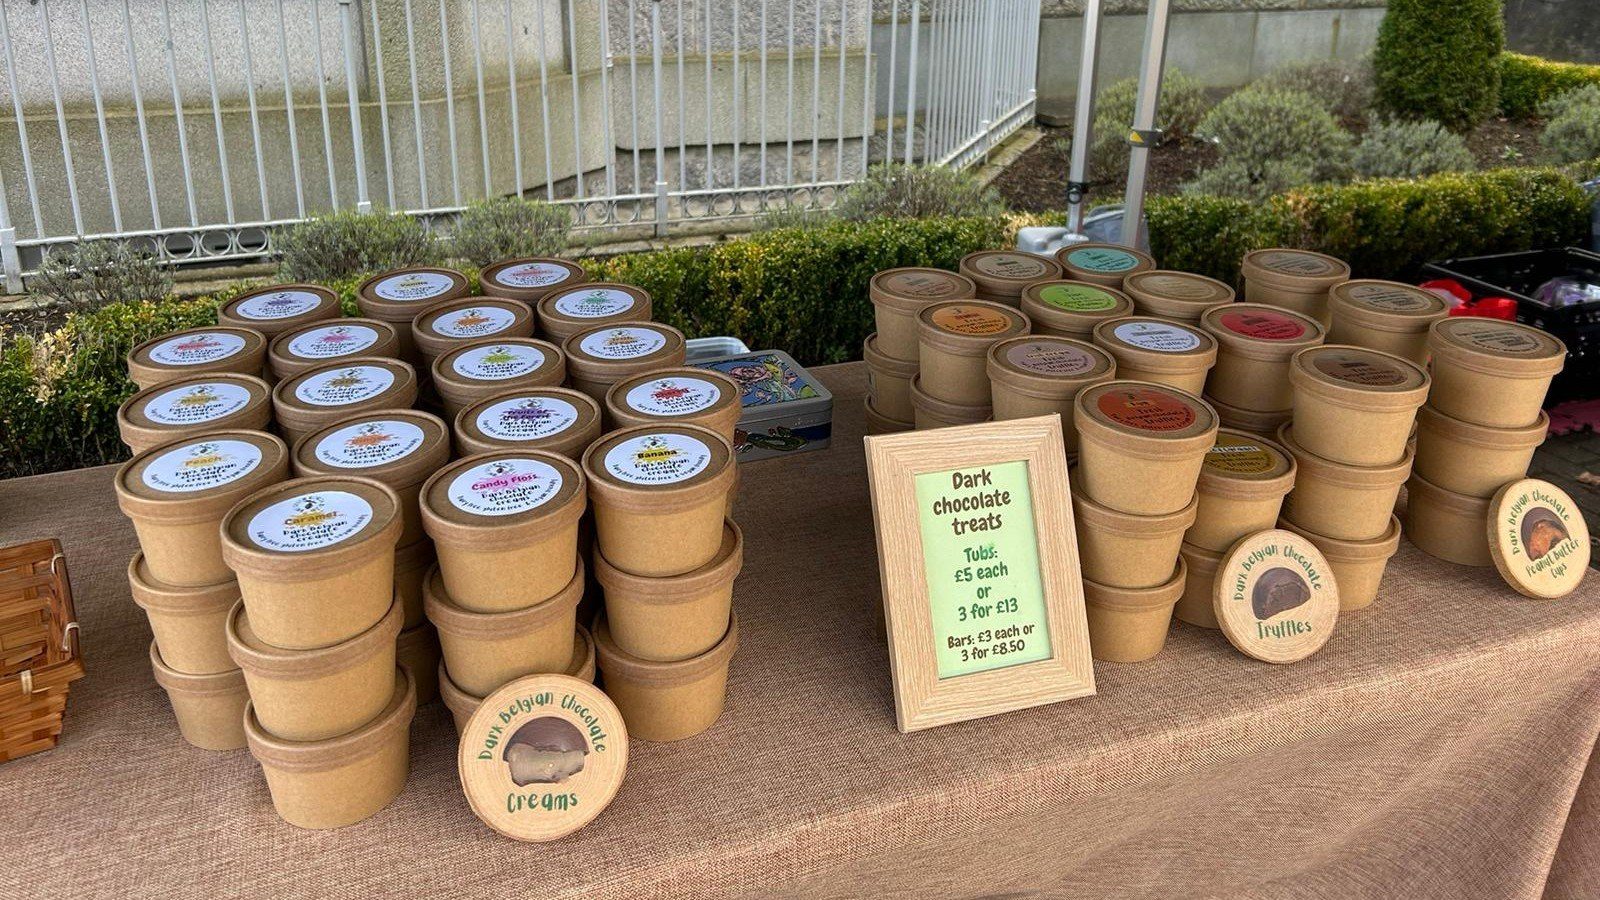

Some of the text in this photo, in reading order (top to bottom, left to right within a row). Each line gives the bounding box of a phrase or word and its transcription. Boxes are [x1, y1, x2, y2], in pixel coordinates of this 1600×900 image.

[185, 456, 222, 466] Peach
[637, 450, 678, 459] Banana
[471, 473, 538, 491] Candy Floss
[952, 469, 992, 490] Dark
[933, 489, 1011, 515] chocolate
[284, 511, 337, 525] Caramel
[952, 512, 1002, 536] treats
[1506, 489, 1570, 555] Dark Belgian Chocolate
[964, 545, 998, 563] Tubs:
[954, 561, 1008, 582] £5 each
[1234, 544, 1322, 600] Dark Belgian Chocolate
[1525, 555, 1554, 577] Peanut
[1550, 563, 1567, 578] Cups
[977, 586, 992, 600] or
[958, 598, 1018, 621] 3 for £13
[948, 623, 1035, 649] Bars: £3 each or
[1256, 620, 1312, 640] Truffles
[961, 639, 1026, 662] 3 for £8.50
[478, 692, 607, 760] Dark Belgian Chocolate
[507, 793, 578, 814] Creams
